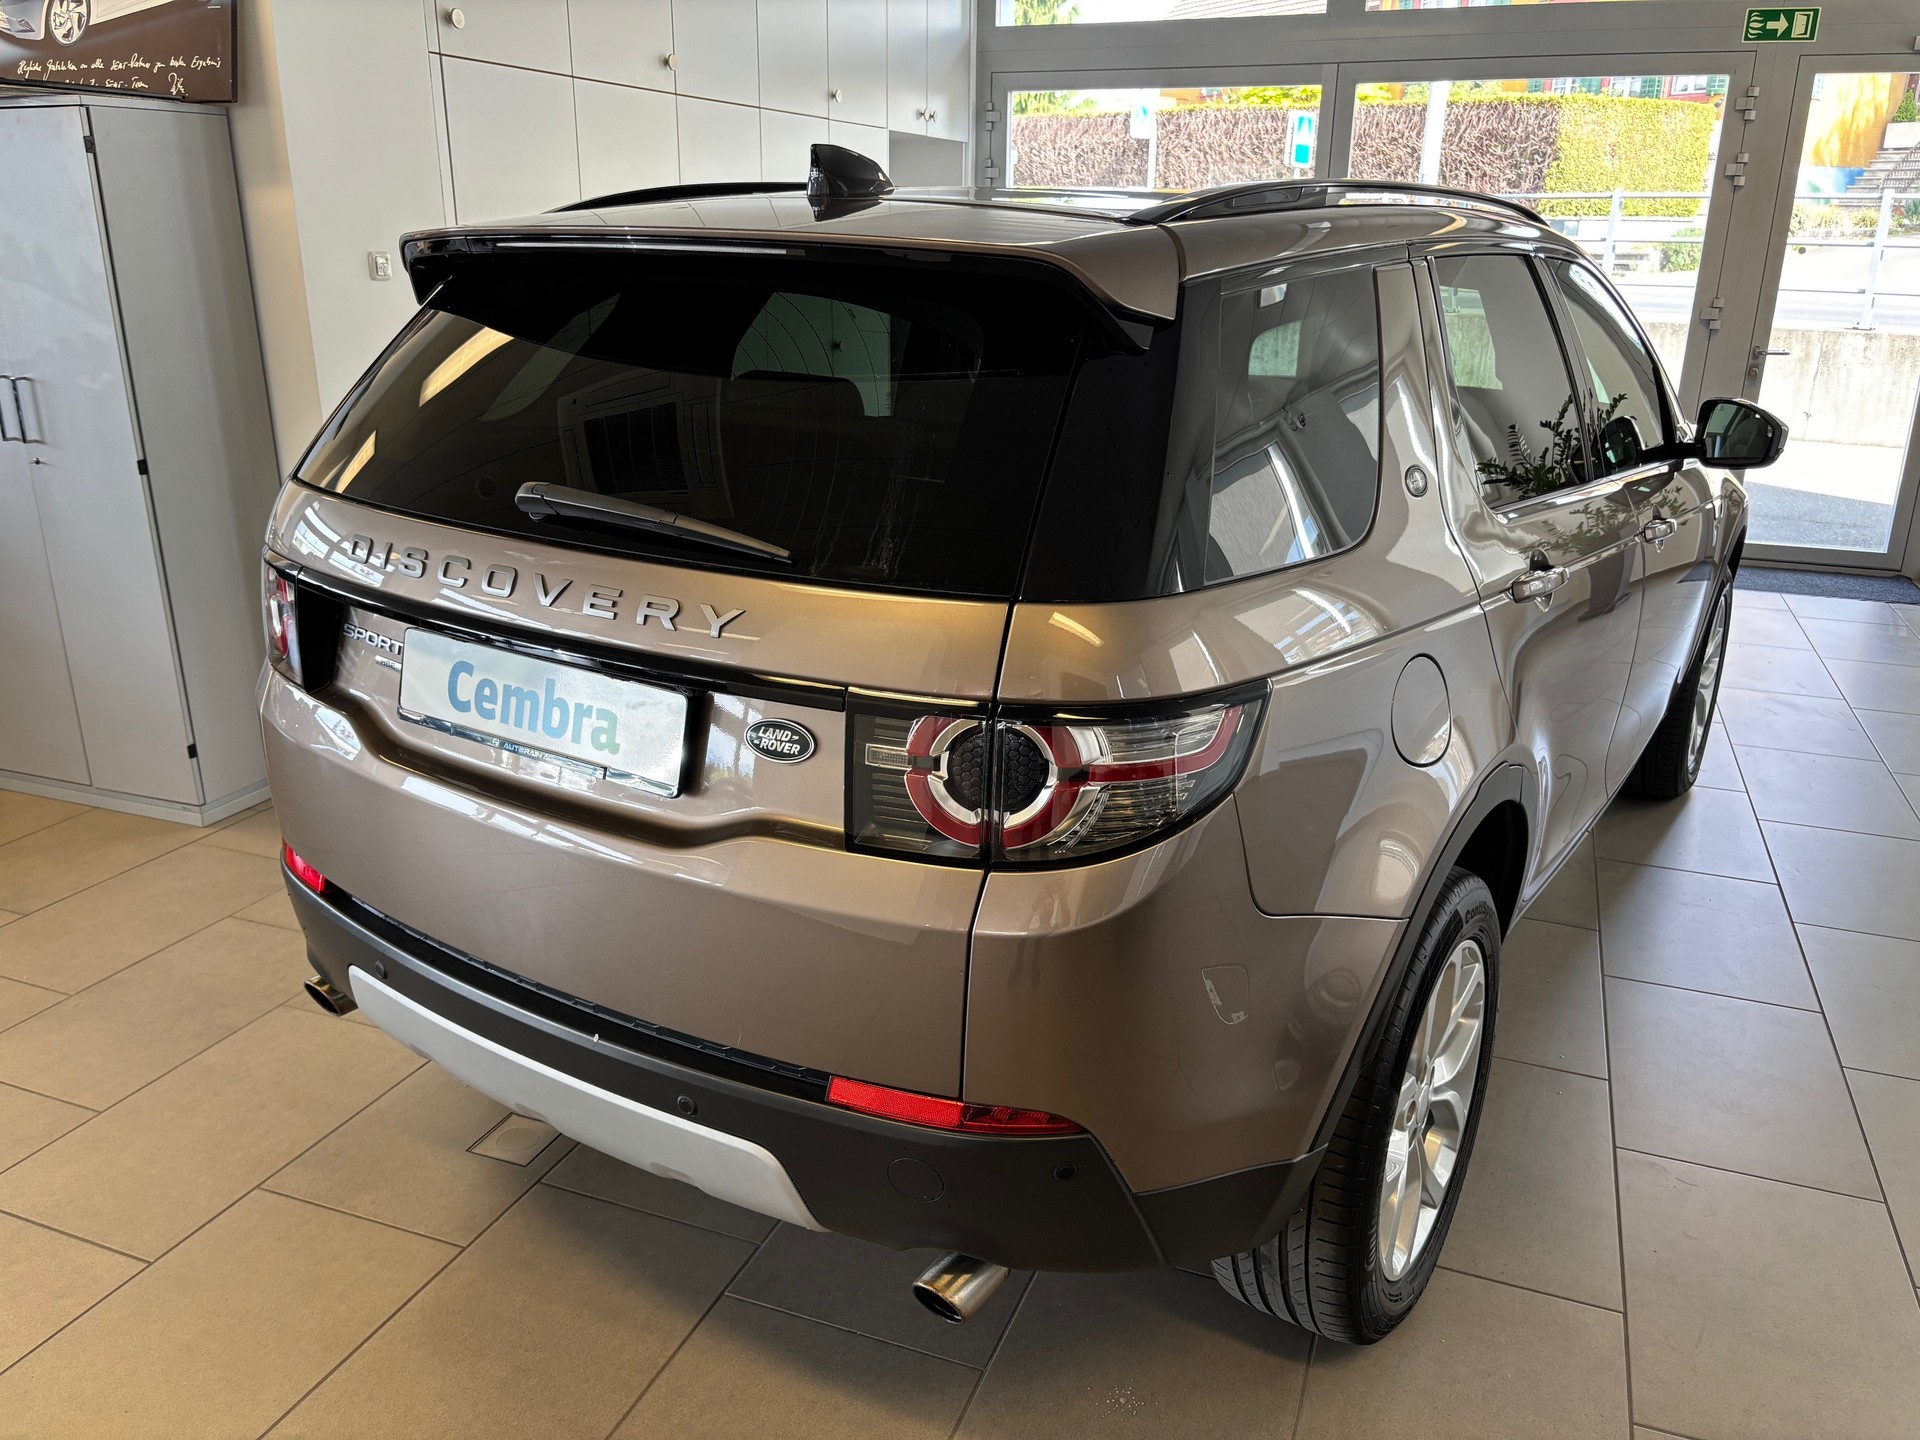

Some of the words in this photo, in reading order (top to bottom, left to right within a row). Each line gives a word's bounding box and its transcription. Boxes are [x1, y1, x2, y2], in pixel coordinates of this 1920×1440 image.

[348, 533, 746, 638] DISCOVERY
[343, 623, 404, 655] SPORT
[447, 660, 620, 756] Cembra
[758, 726, 792, 742] LAND
[759, 737, 801, 755] ROVER
